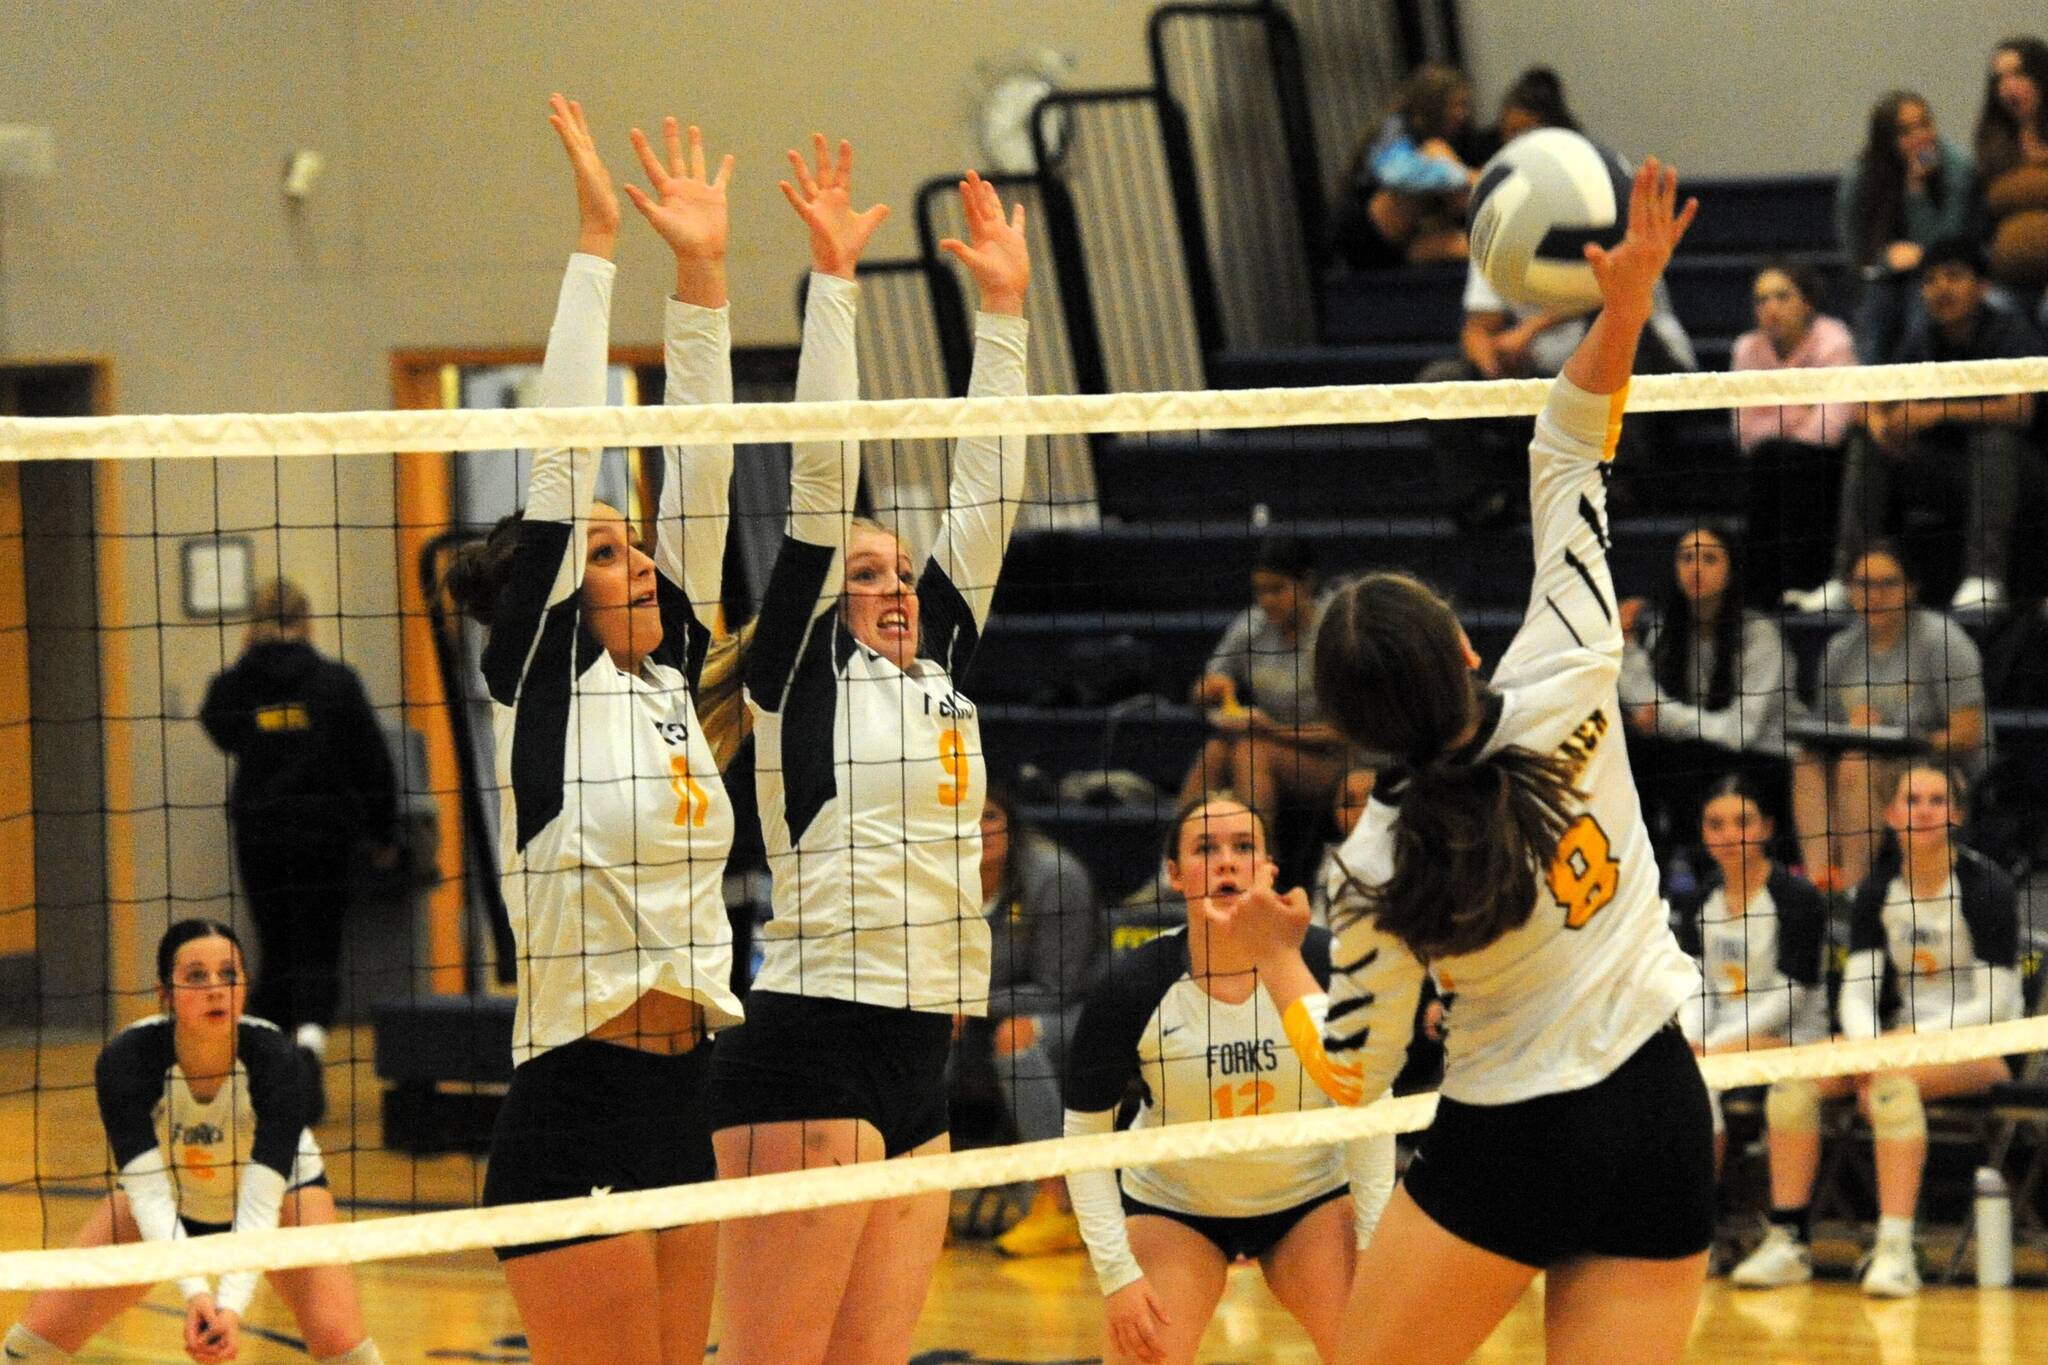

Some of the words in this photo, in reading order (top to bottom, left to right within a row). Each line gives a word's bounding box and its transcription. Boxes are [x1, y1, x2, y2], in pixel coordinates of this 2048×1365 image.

[937, 729, 969, 807] 9
[1206, 1039, 1278, 1078] FORKS
[1213, 1080, 1276, 1119] 12
